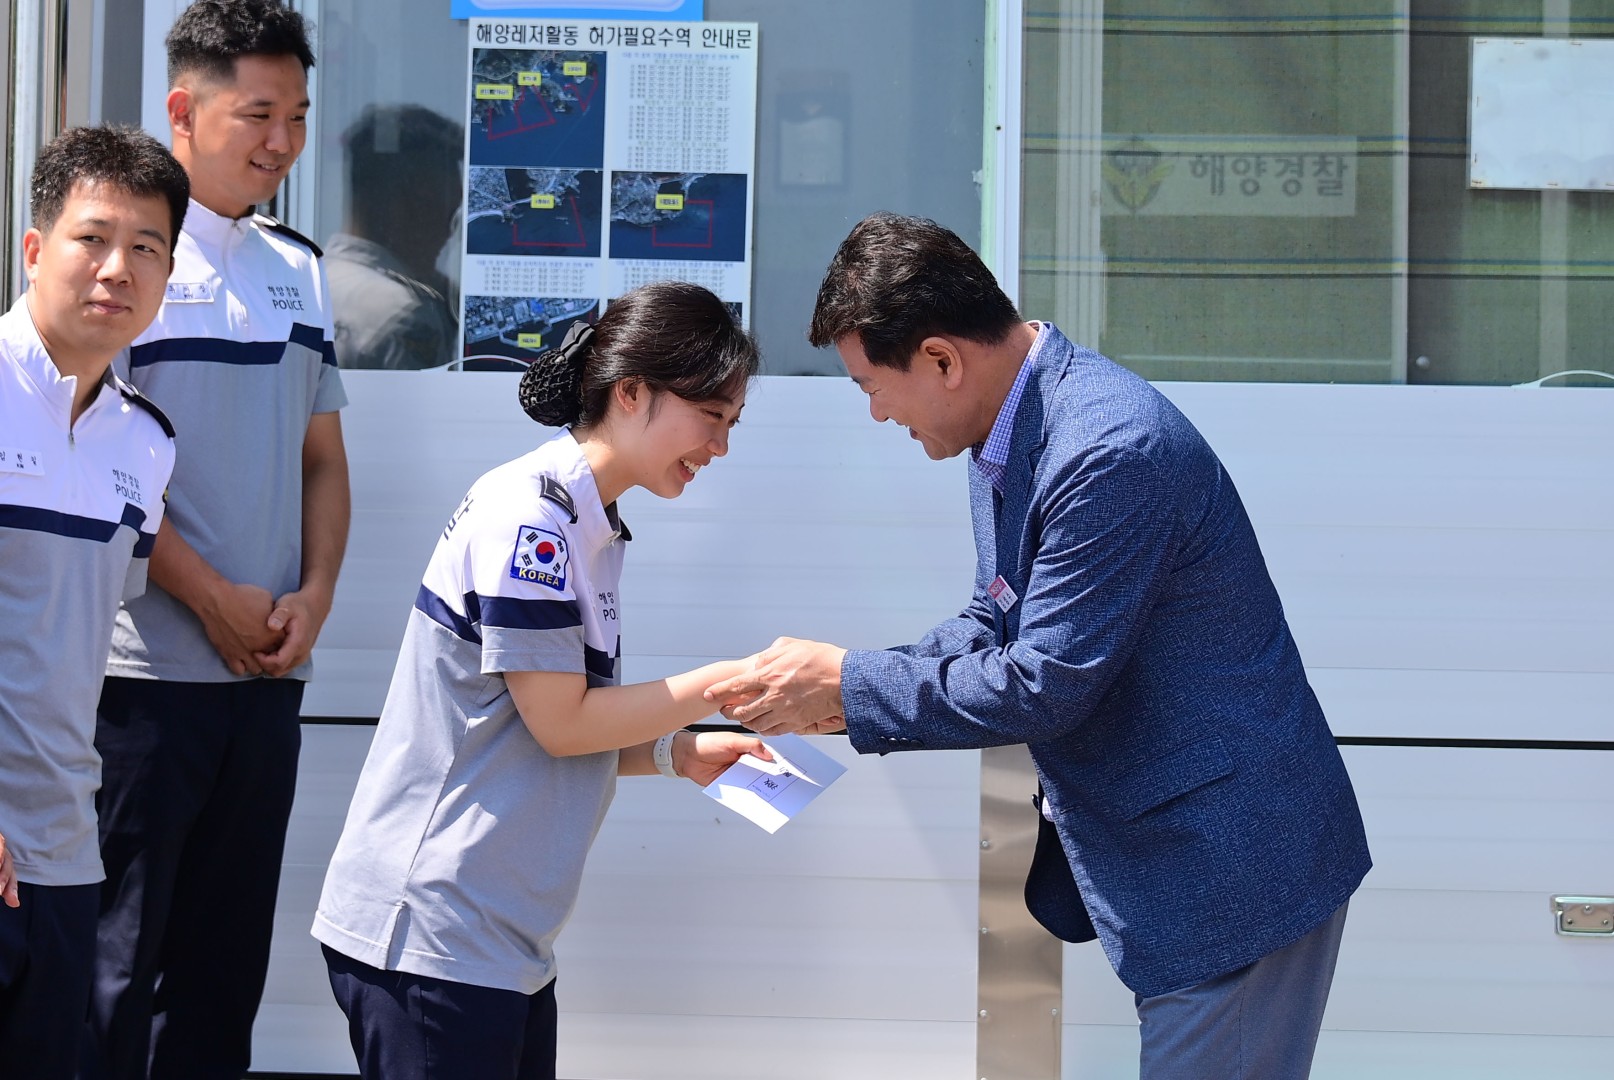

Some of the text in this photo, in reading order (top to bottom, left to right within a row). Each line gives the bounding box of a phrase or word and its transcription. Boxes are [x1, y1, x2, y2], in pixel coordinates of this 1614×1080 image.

[476, 23, 752, 49] 해양레저활동 허가필요수역 안내문
[1189, 154, 1348, 197] 해양경찰
[272, 299, 304, 311] POLICE
[115, 483, 143, 504] POLICE
[519, 567, 559, 587] KOREA
